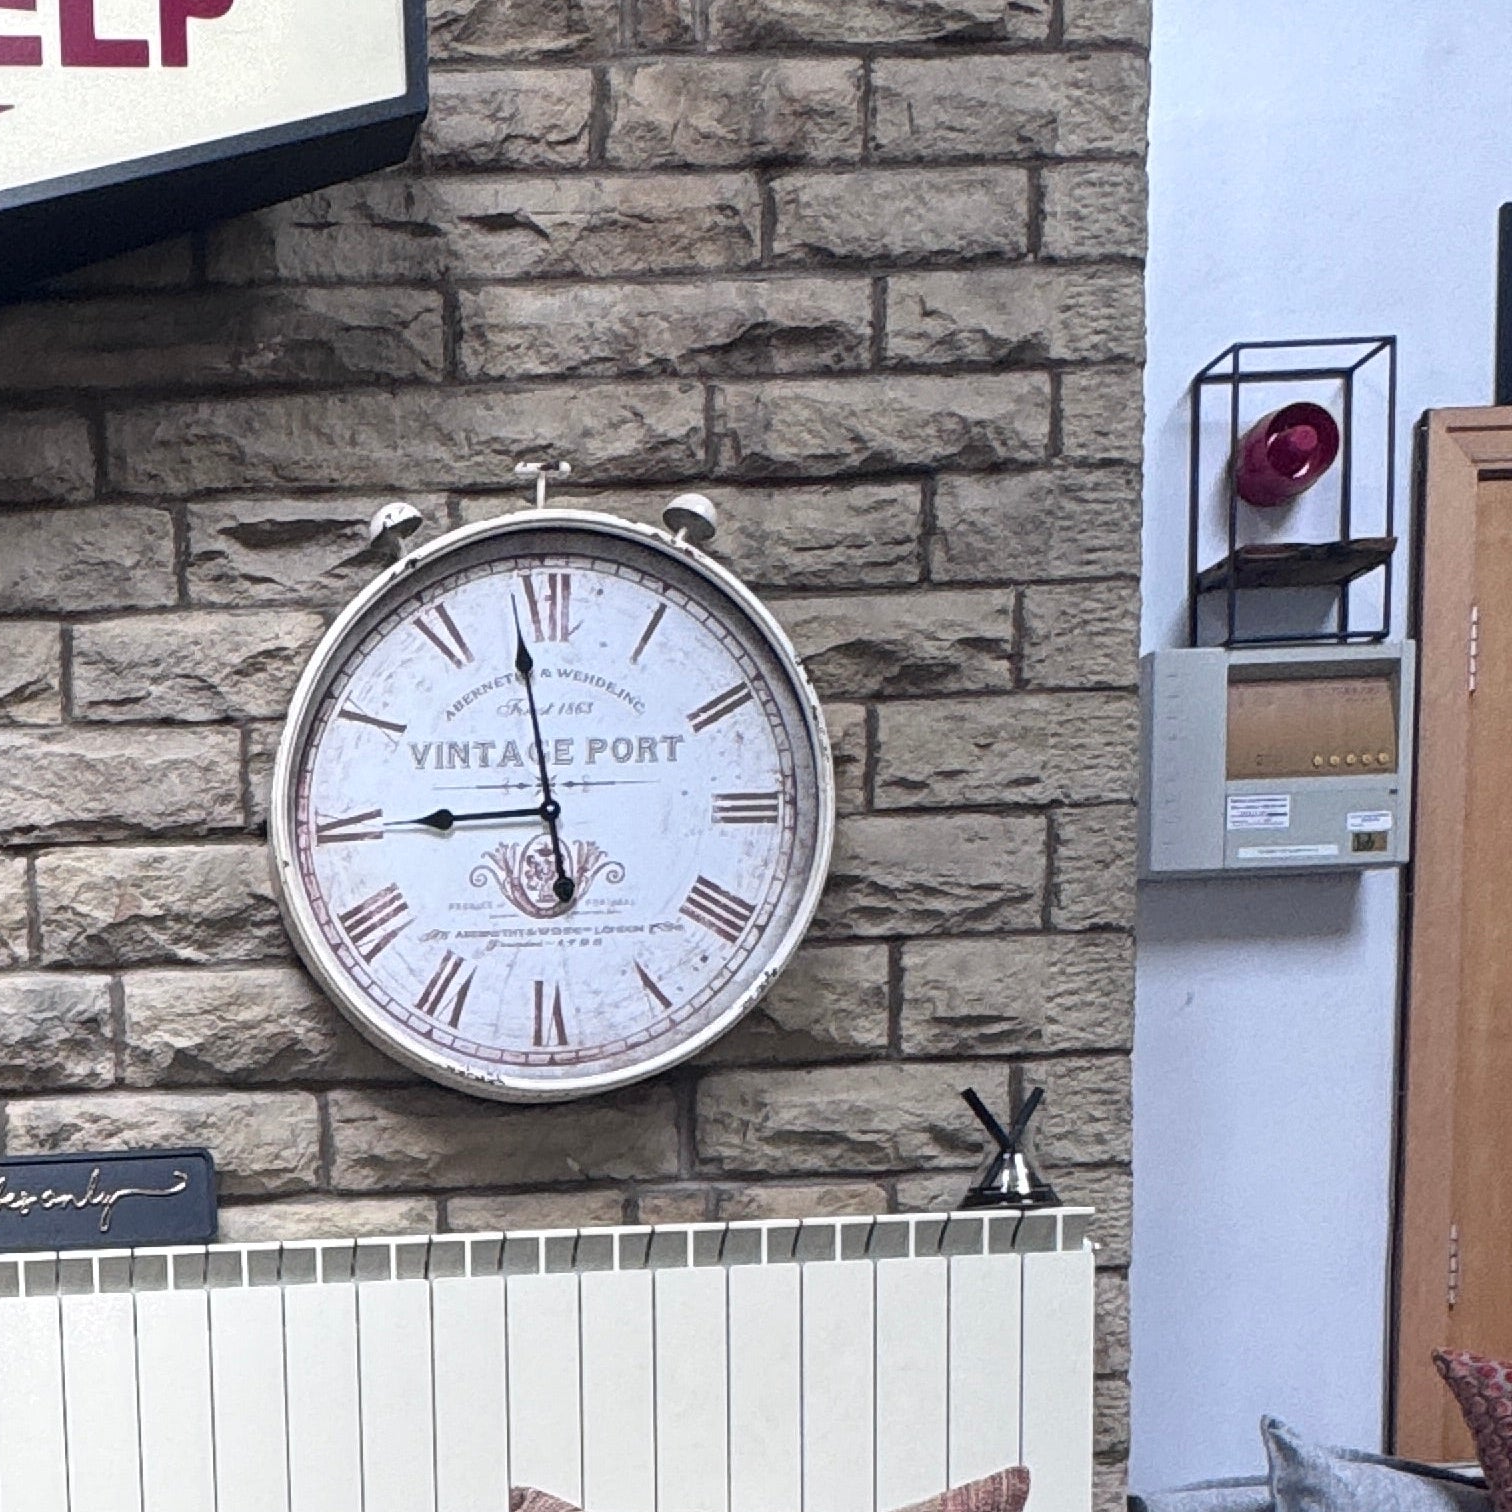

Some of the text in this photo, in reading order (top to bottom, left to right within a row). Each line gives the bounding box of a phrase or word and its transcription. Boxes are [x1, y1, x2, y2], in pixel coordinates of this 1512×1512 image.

[446, 671, 533, 721] ABERNET
[408, 734, 685, 770] VINTAGE PORT
[712, 791, 778, 823] III
[41, 1168, 187, 1232] only
